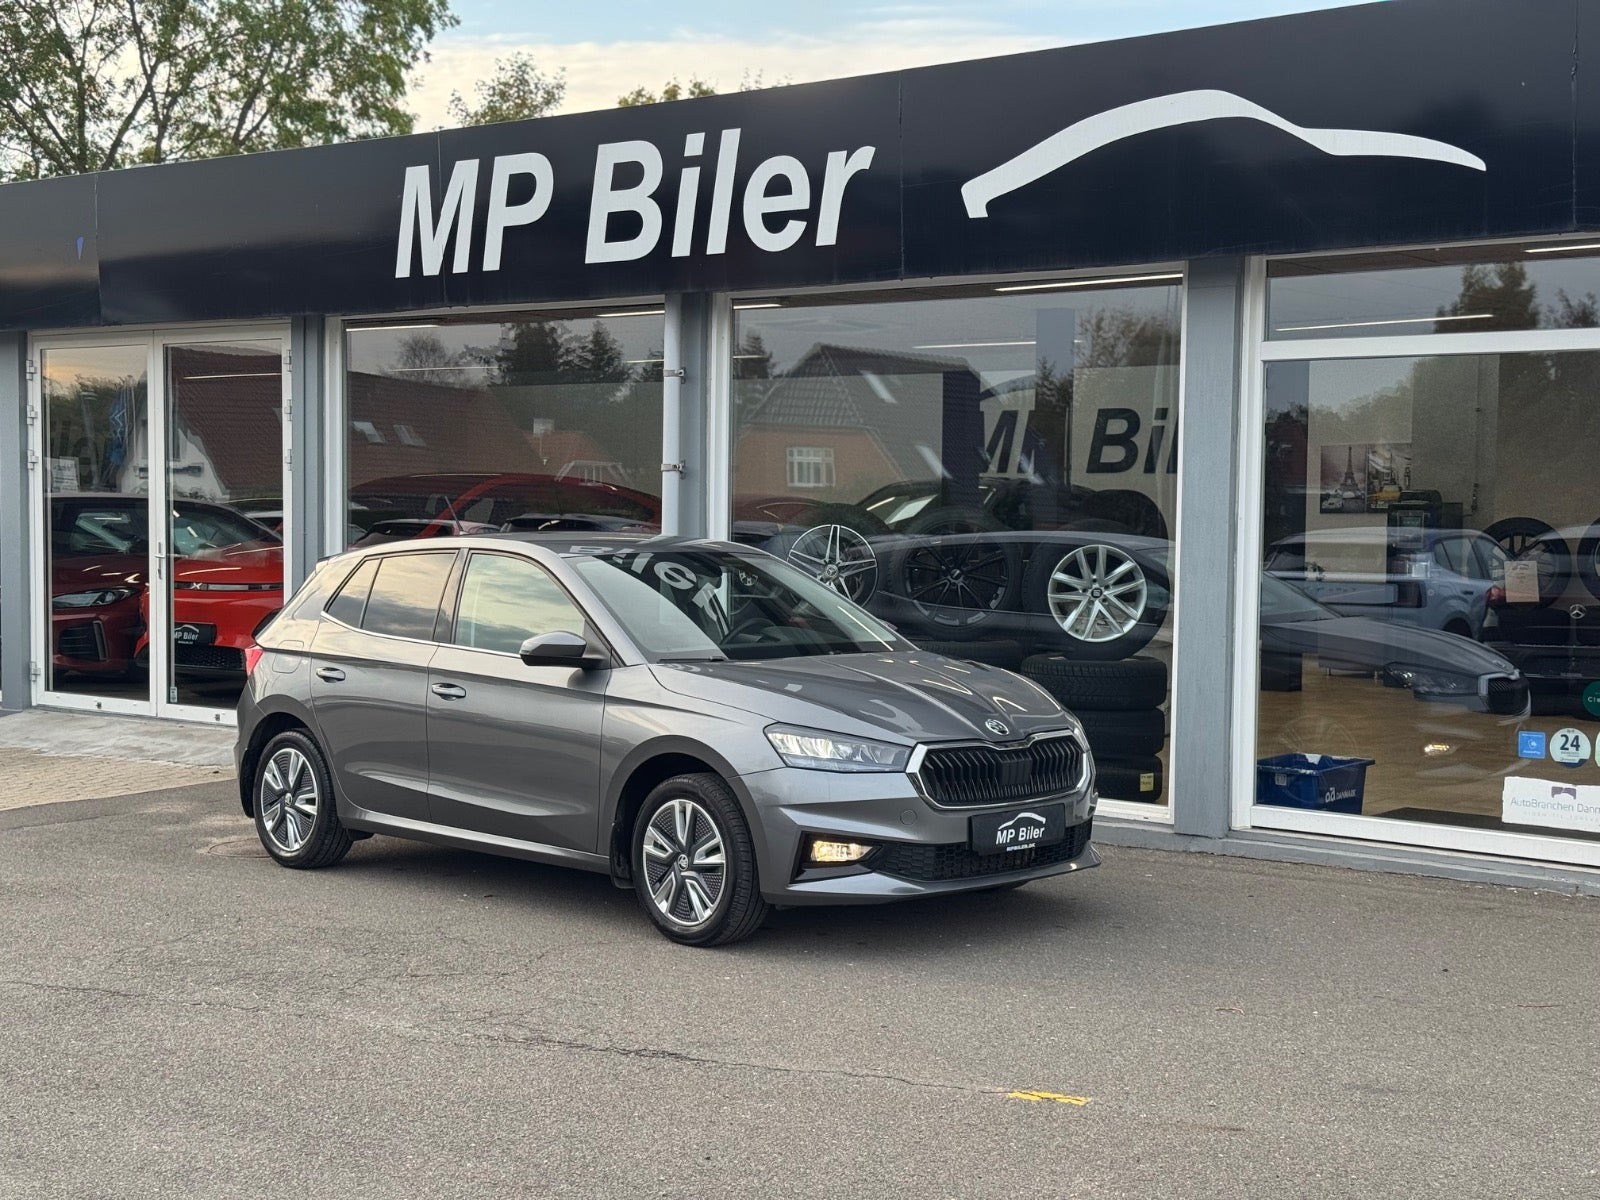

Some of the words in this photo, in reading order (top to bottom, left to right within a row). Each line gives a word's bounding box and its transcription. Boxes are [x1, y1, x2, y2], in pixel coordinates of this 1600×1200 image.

[395, 152, 554, 278] MP
[584, 128, 876, 265] Biler
[1560, 734, 1580, 751] 24
[1511, 797, 1574, 812] AutoBranchen
[996, 829, 1015, 844] MP
[1019, 825, 1045, 840] Biler
